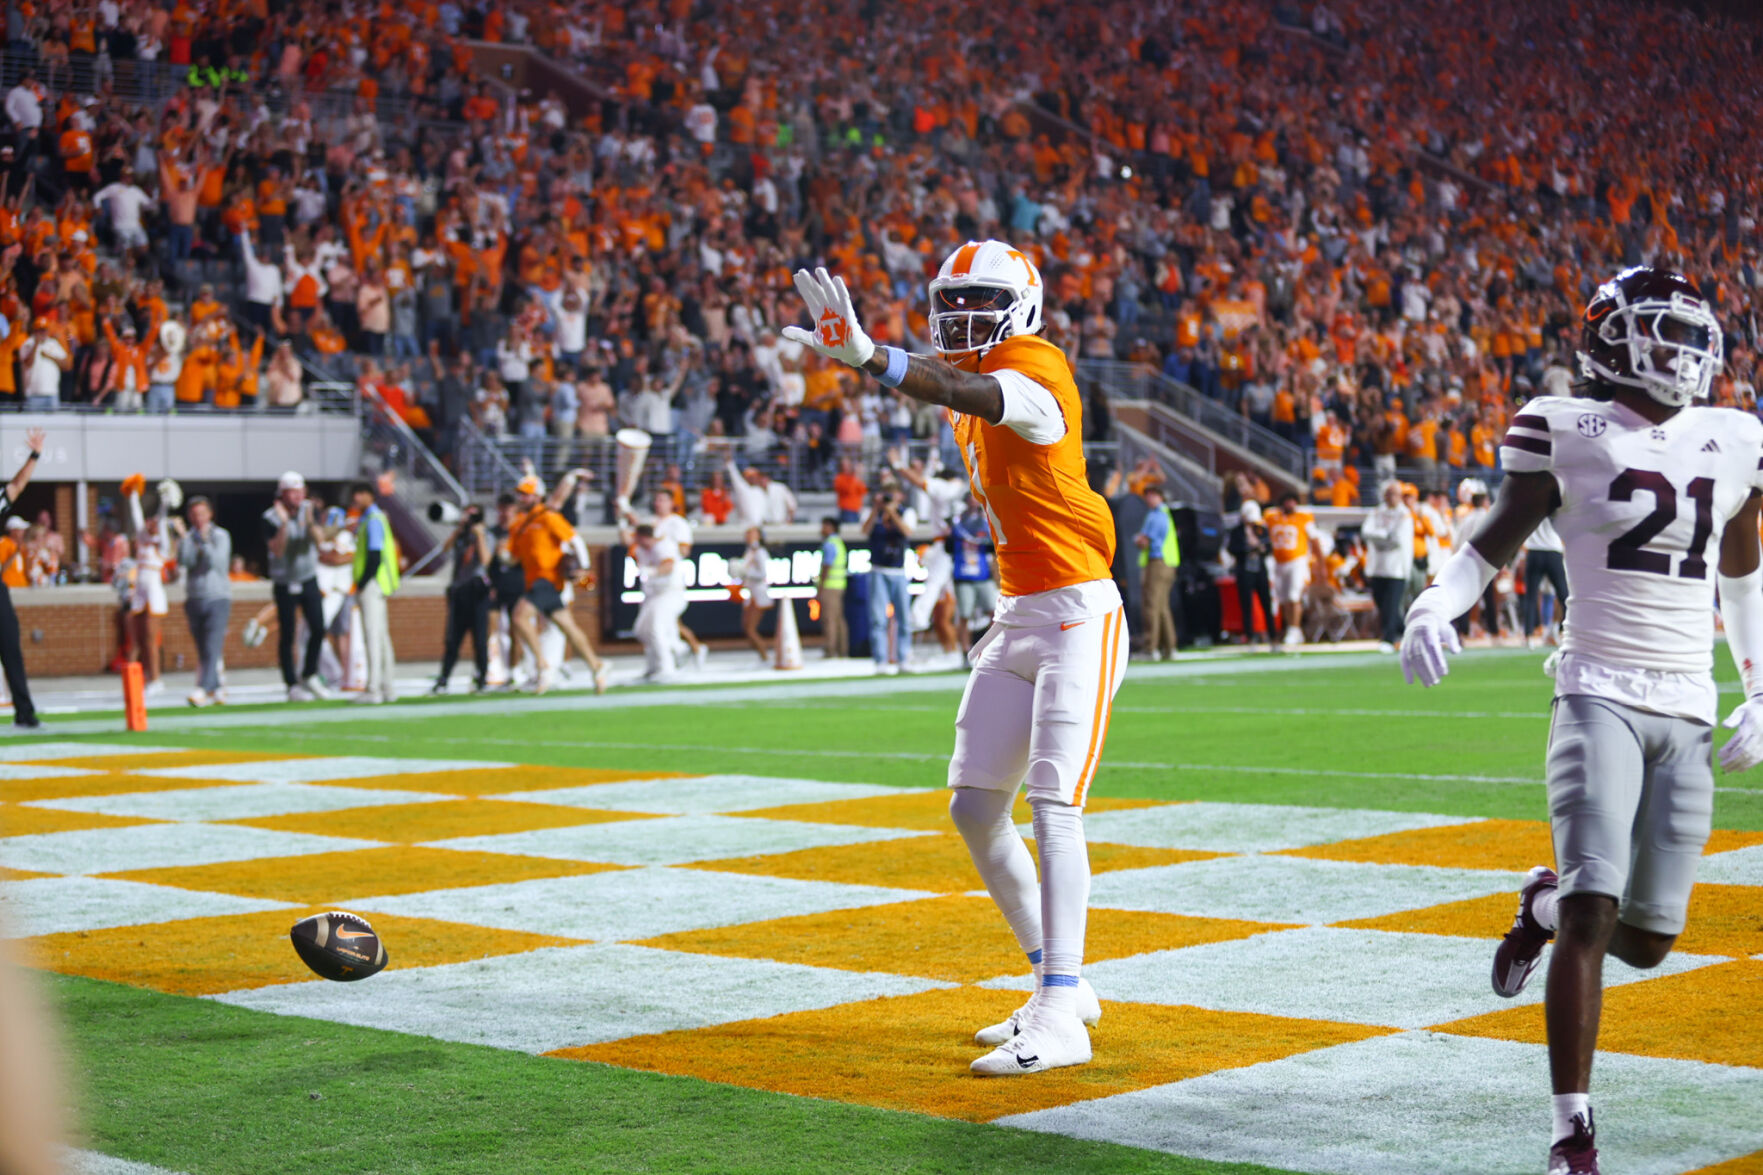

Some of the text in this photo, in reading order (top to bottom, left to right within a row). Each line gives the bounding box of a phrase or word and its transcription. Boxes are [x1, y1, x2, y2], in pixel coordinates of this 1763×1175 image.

[1005, 250, 1039, 287] T
[821, 317, 842, 342] T
[1578, 414, 1606, 437] SEC
[1606, 467, 1716, 581] 21
